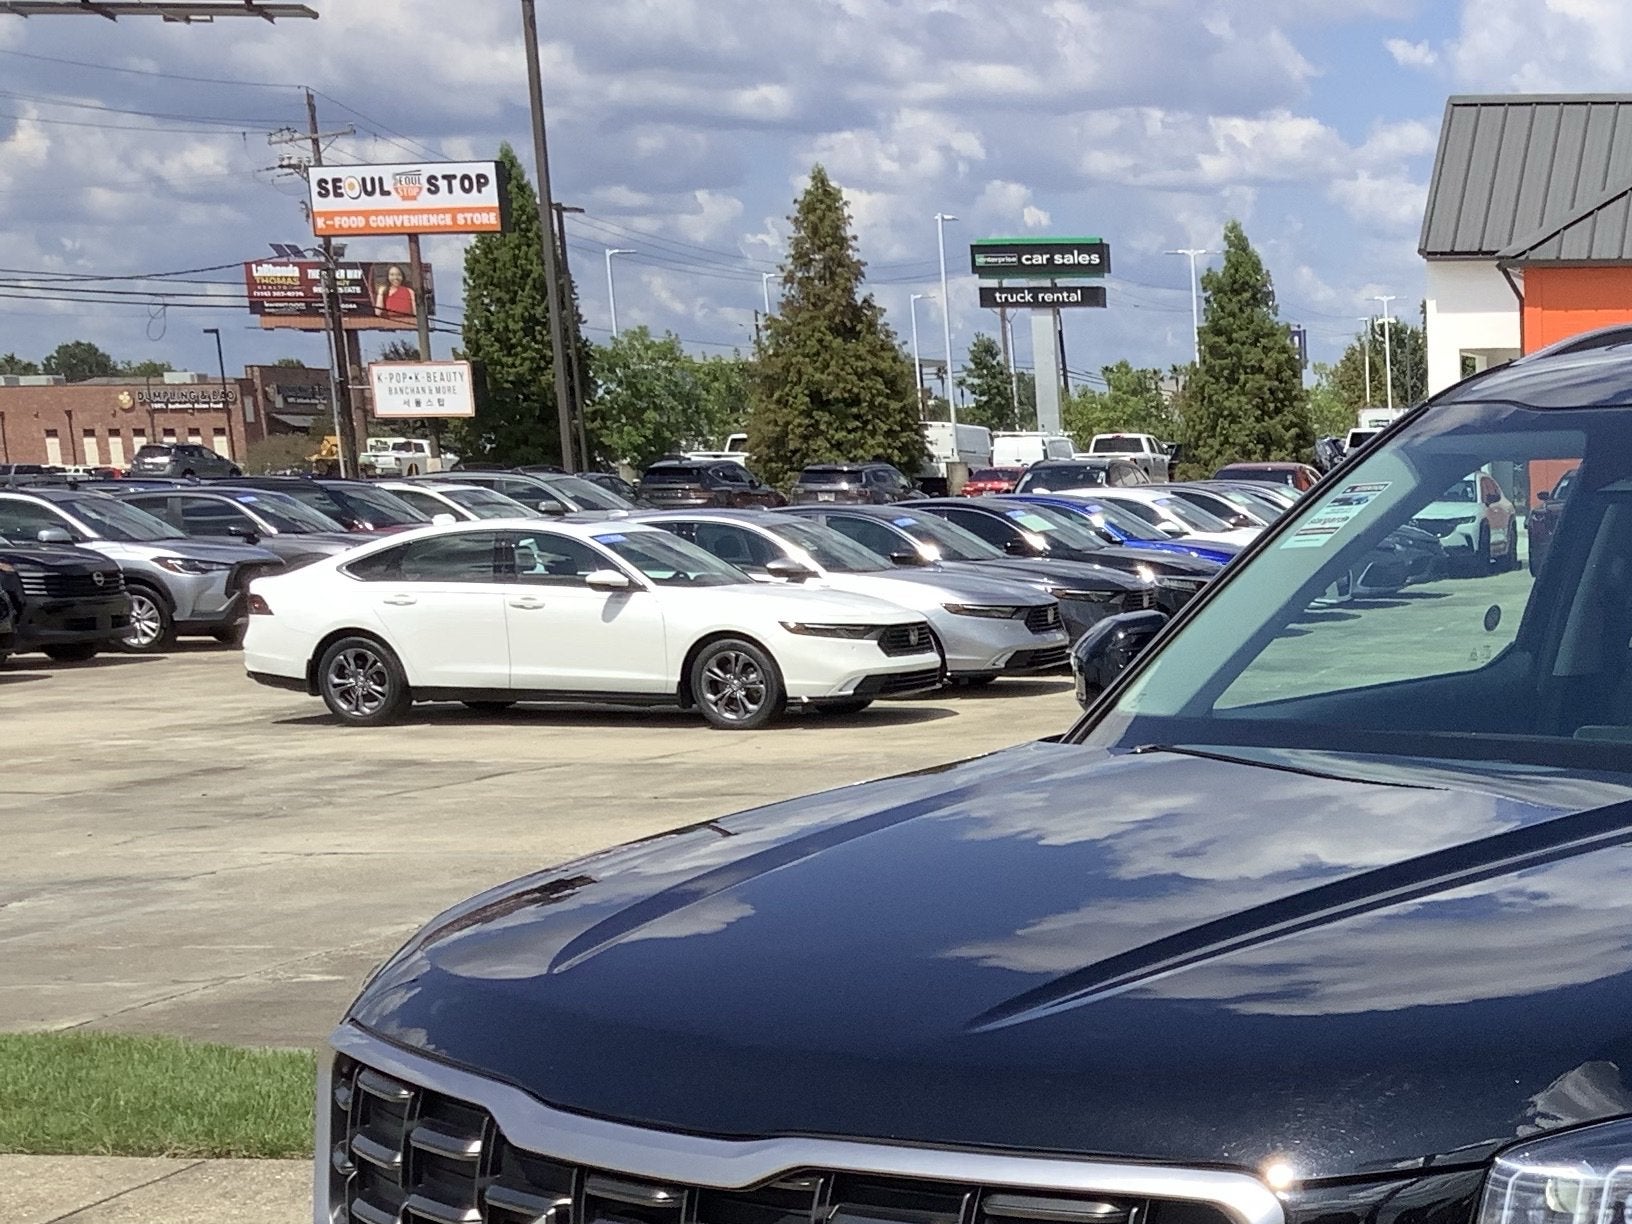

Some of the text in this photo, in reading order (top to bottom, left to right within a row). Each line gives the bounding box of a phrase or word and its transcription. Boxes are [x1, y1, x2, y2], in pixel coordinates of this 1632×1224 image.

[317, 174, 490, 200] SEOUL STOP
[397, 187, 421, 197] STOP
[316, 212, 497, 229] K-FOOD CONVENIENCE STORE
[1021, 254, 1050, 265] car
[1054, 250, 1100, 265] sales
[995, 290, 1081, 303] truck rental
[138, 391, 196, 402] DUMPLING
[388, 386, 426, 396] BANCHAN
[435, 386, 457, 395] MORE
